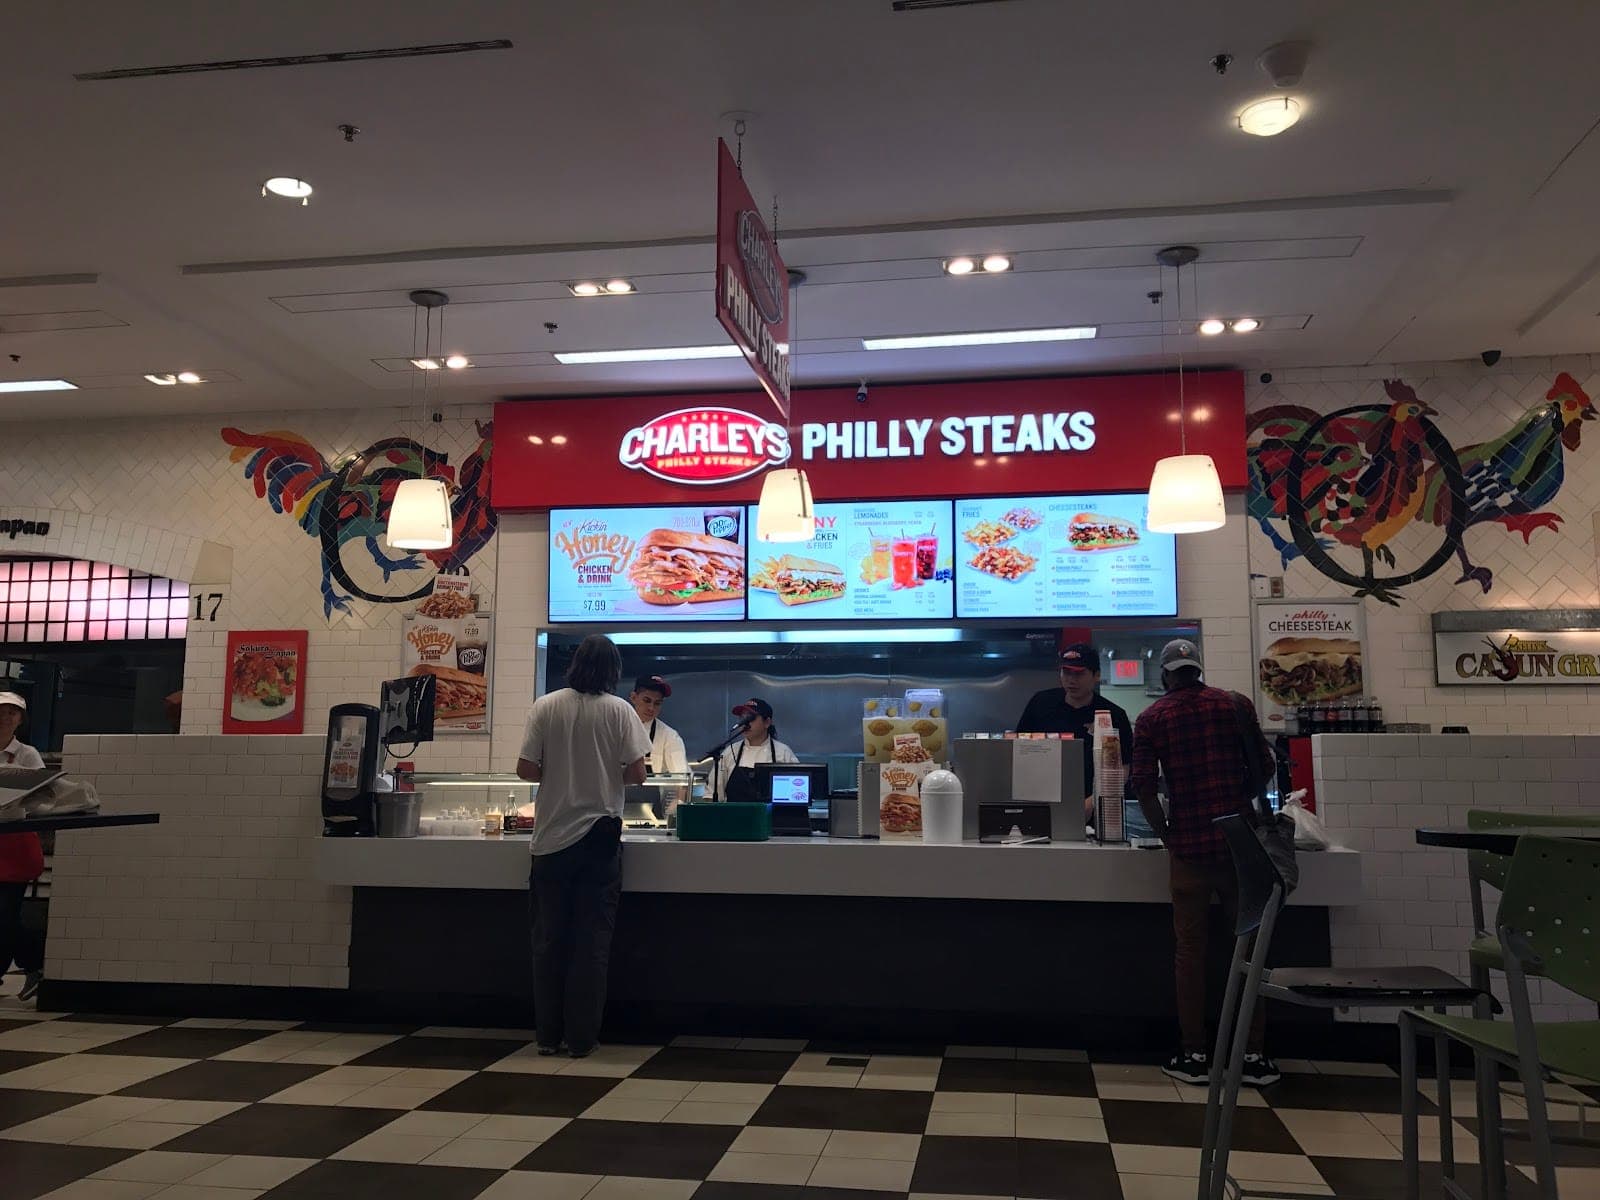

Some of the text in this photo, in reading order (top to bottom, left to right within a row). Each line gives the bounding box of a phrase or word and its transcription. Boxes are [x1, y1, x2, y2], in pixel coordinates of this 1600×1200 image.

[727, 264, 762, 352] PHILLY
[620, 422, 790, 462] CHARLEYS
[802, 411, 1096, 460] PHILLY STEAKS
[657, 456, 700, 468] PHILLY
[554, 527, 636, 574] Honey
[814, 542, 833, 550] FRIES
[577, 575, 612, 583] & DRINK
[578, 565, 613, 574] CHICKEN
[193, 593, 223, 622] 17
[584, 600, 606, 612] $7.99
[1291, 610, 1330, 620] philly
[1268, 620, 1352, 632] CHEESESTEAK
[407, 628, 456, 656] Honey
[1455, 653, 1600, 682] CAJUN GR
